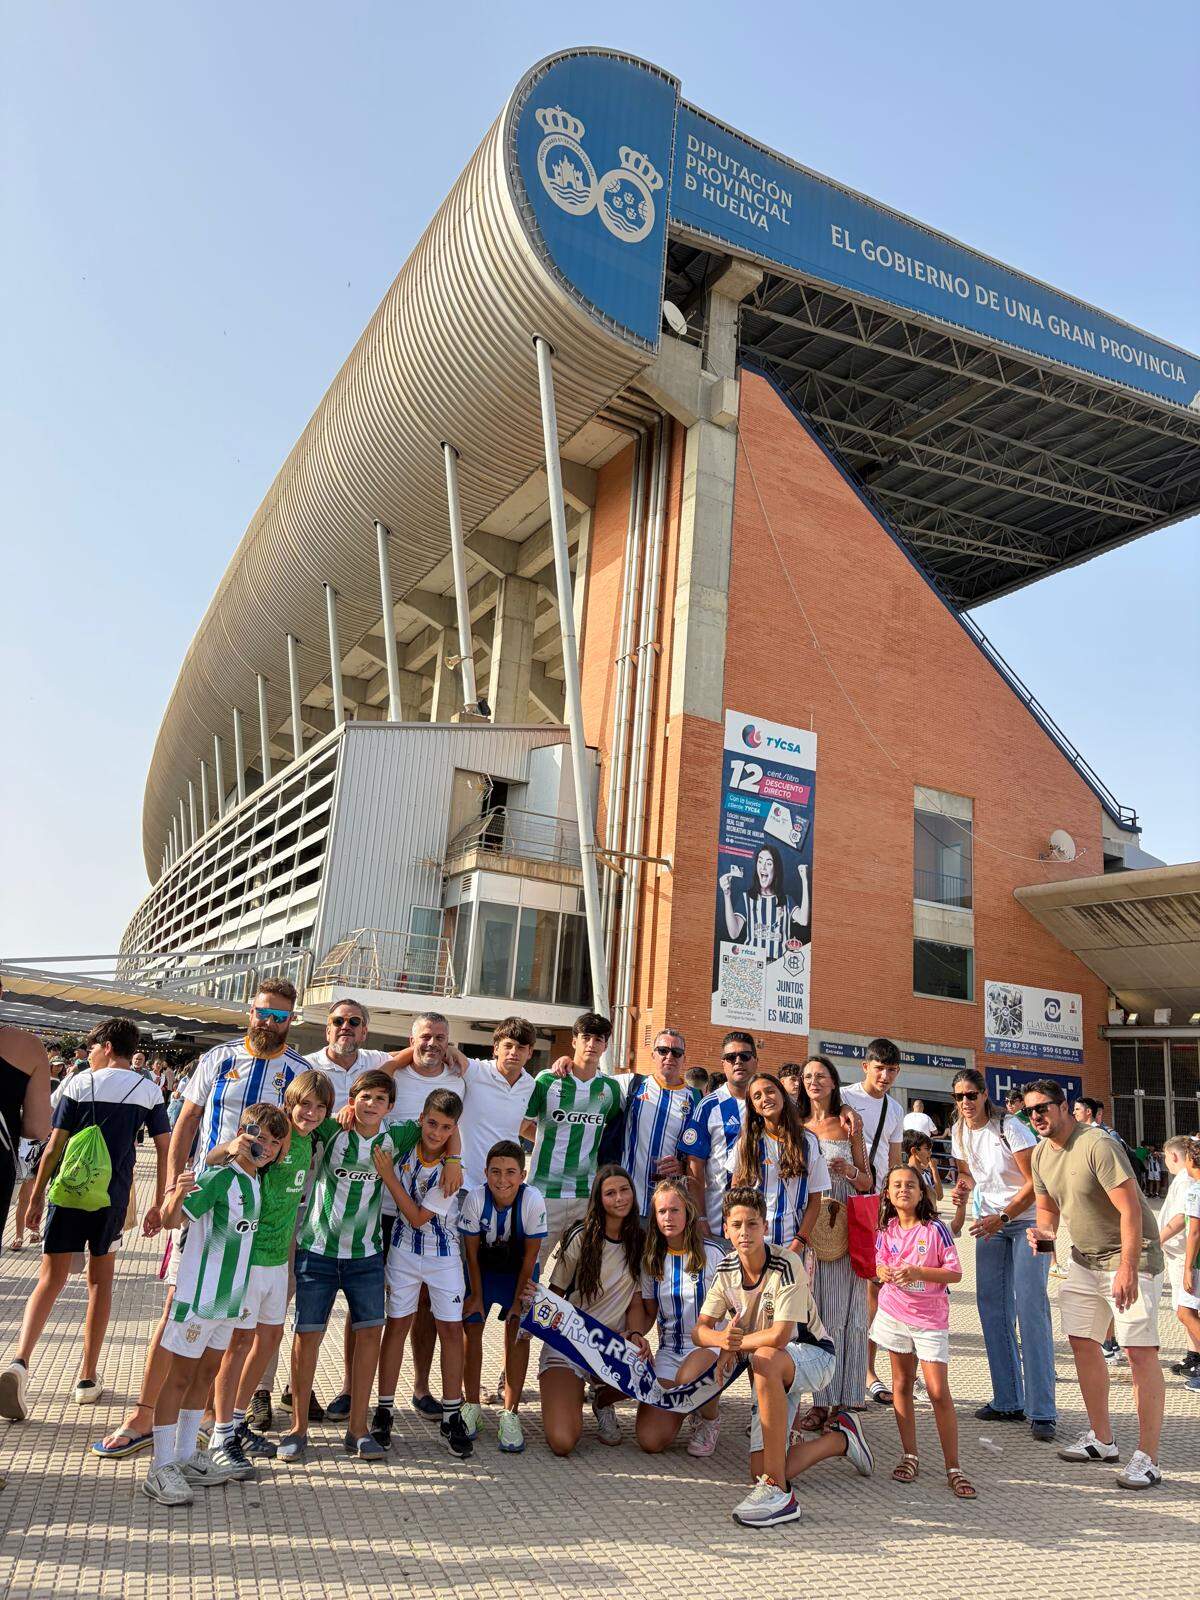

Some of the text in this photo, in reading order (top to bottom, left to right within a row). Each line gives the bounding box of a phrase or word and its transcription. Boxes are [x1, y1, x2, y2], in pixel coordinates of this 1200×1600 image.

[687, 134, 792, 208] DIPUTACIÓN
[686, 152, 790, 225] PROVINCIAL
[702, 182, 769, 232] HUELVA
[830, 223, 1187, 384] EL GOBIERNO DE UNA GRAN PROVINCIA
[729, 760, 763, 794] 12
[764, 786, 792, 799] DIRECTO
[765, 779, 804, 793] DESCUENTO
[776, 980, 804, 994] JUNTOS
[777, 995, 804, 1010] HUELVA
[768, 1009, 777, 1022] ES
[779, 1010, 803, 1025] MEJOR
[567, 1112, 603, 1125] GREE
[601, 1365, 621, 1382] de
